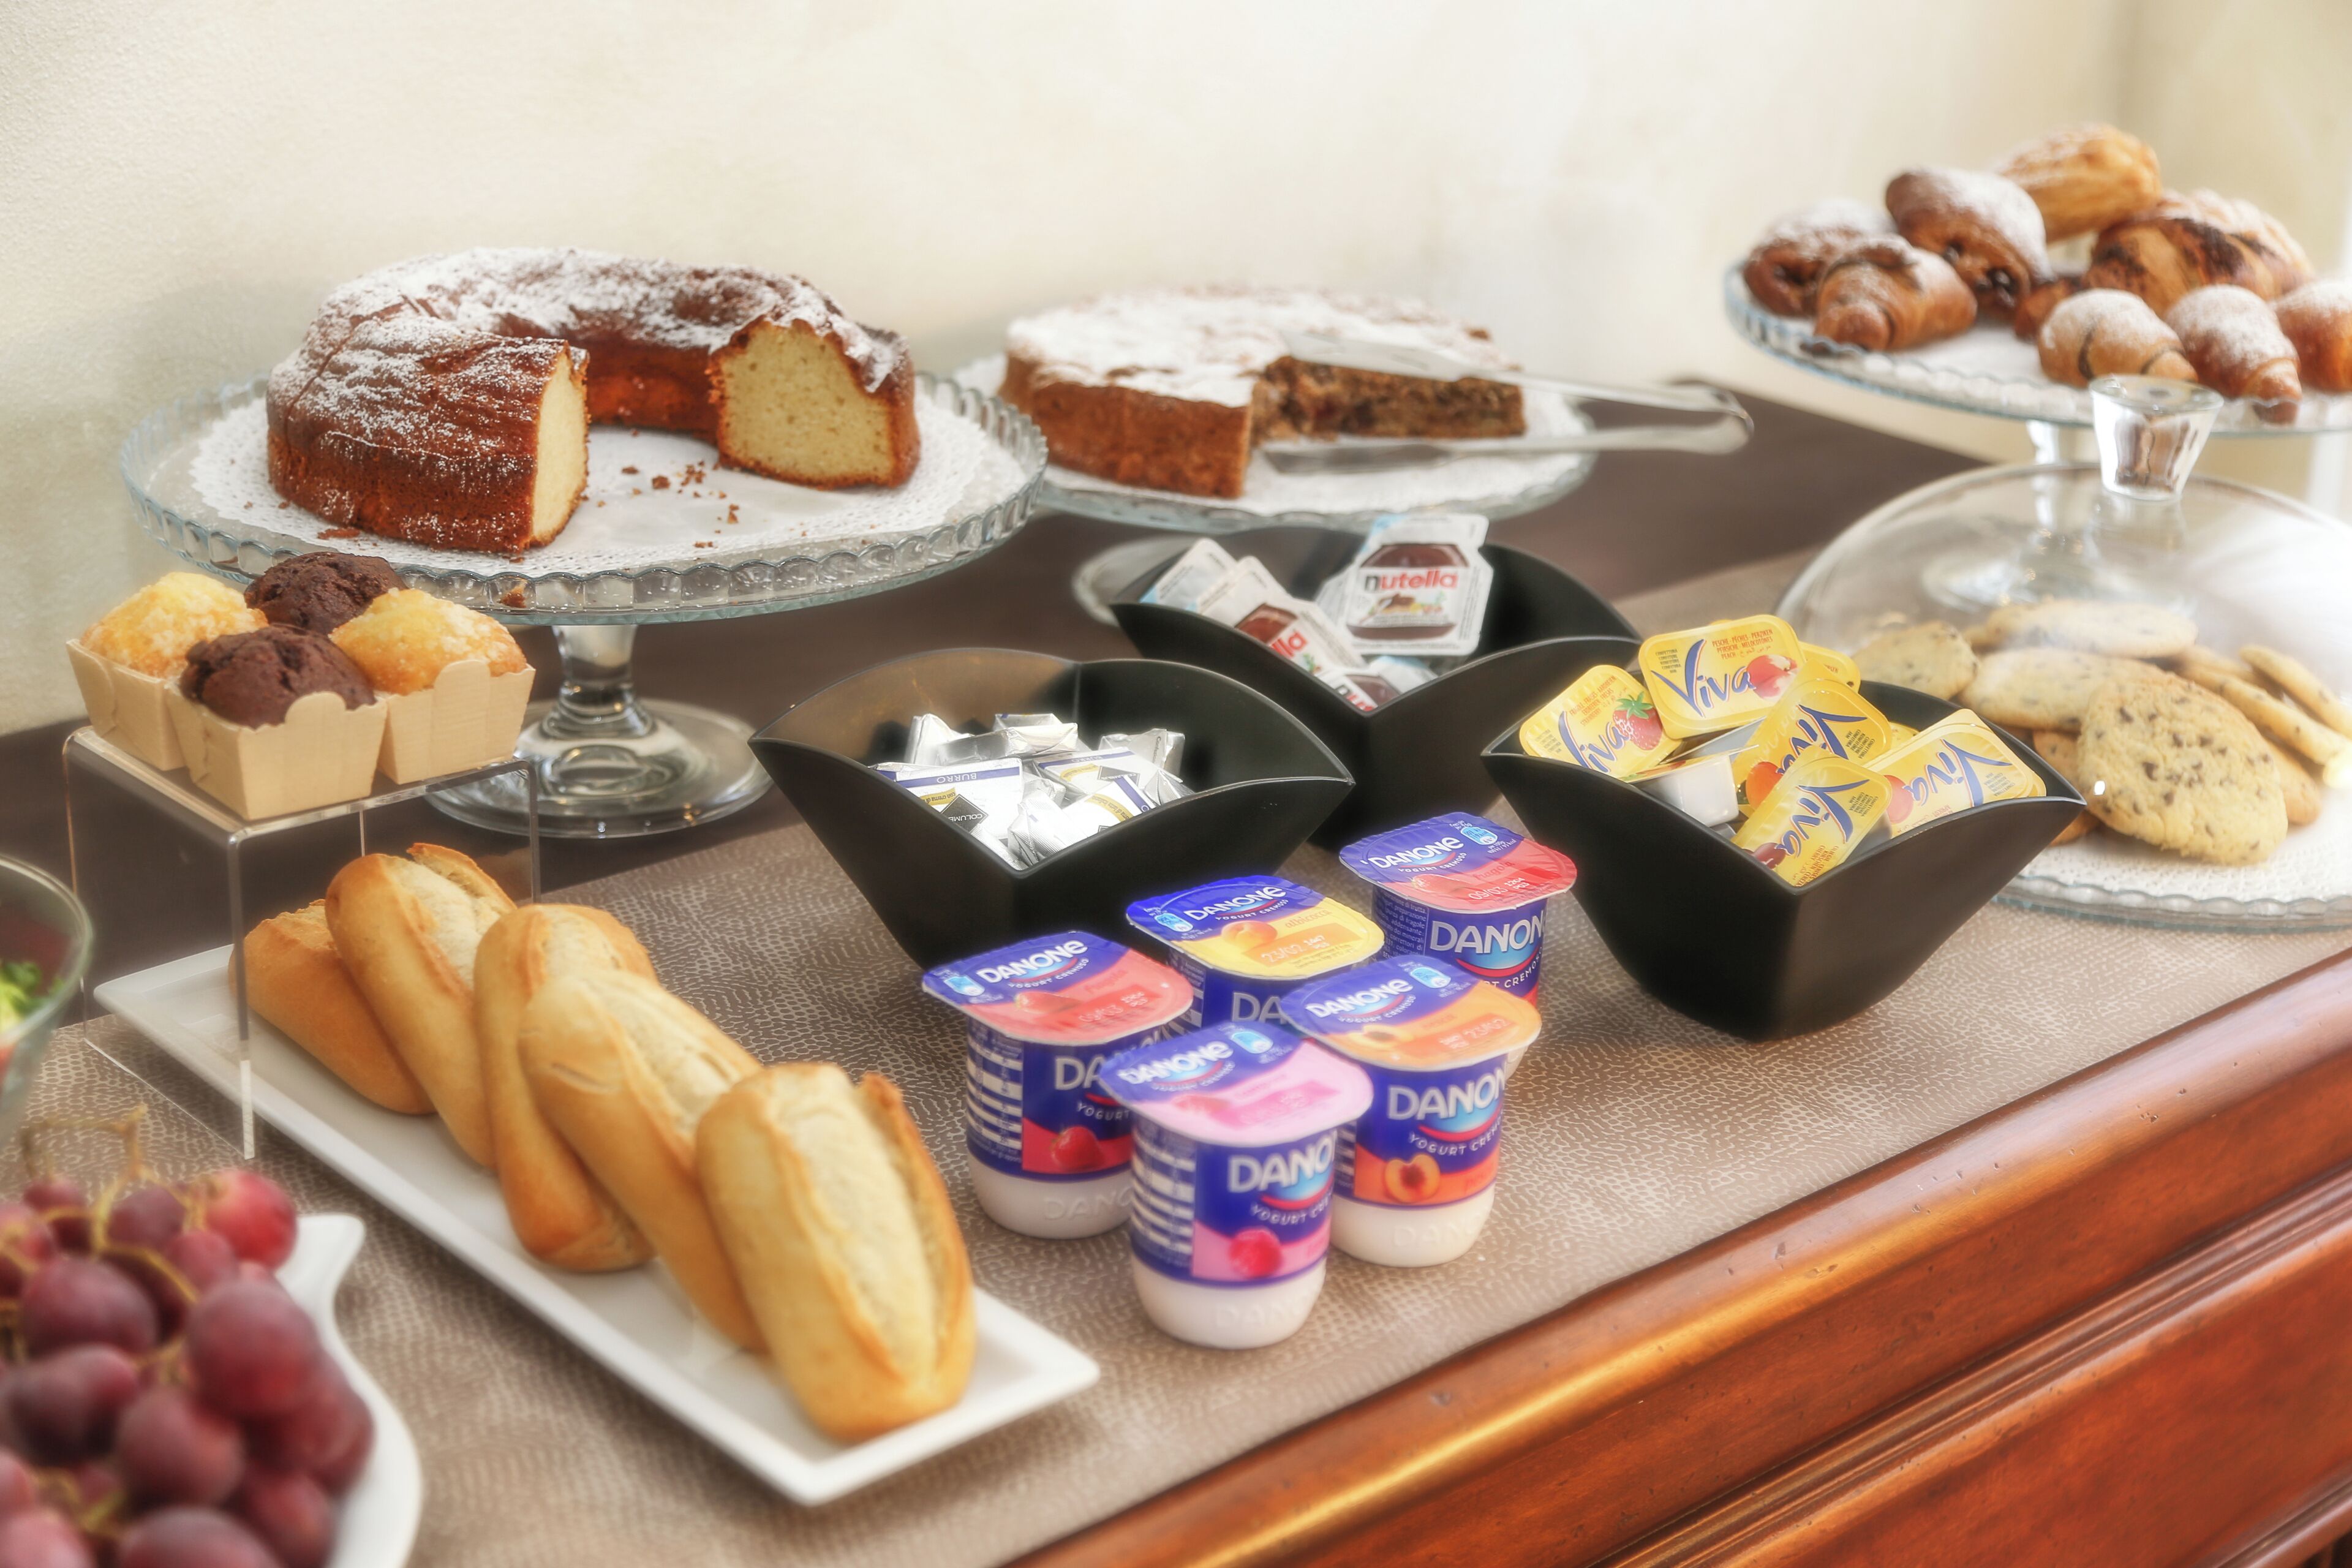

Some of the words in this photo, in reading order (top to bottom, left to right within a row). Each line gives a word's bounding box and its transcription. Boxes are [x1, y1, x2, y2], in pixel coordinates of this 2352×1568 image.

[1365, 568, 1458, 592] nutella
[1651, 639, 1757, 718] Viva
[936, 772, 976, 783] BURRO
[1902, 739, 2013, 808] Viva
[1774, 778, 1871, 858] Viva
[1373, 837, 1464, 869] DANONE
[1184, 886, 1287, 921] DANONE
[1430, 910, 1544, 954] DANON
[976, 940, 1088, 984] DANONE
[1305, 978, 1414, 1019] DANONE
[1117, 1041, 1234, 1085] DANONE
[1387, 1063, 1507, 1121] DANON
[1227, 1134, 1334, 1194] DANO
[1409, 1131, 1468, 1156] YOGURT
[1251, 1201, 1308, 1226] YOGURT
